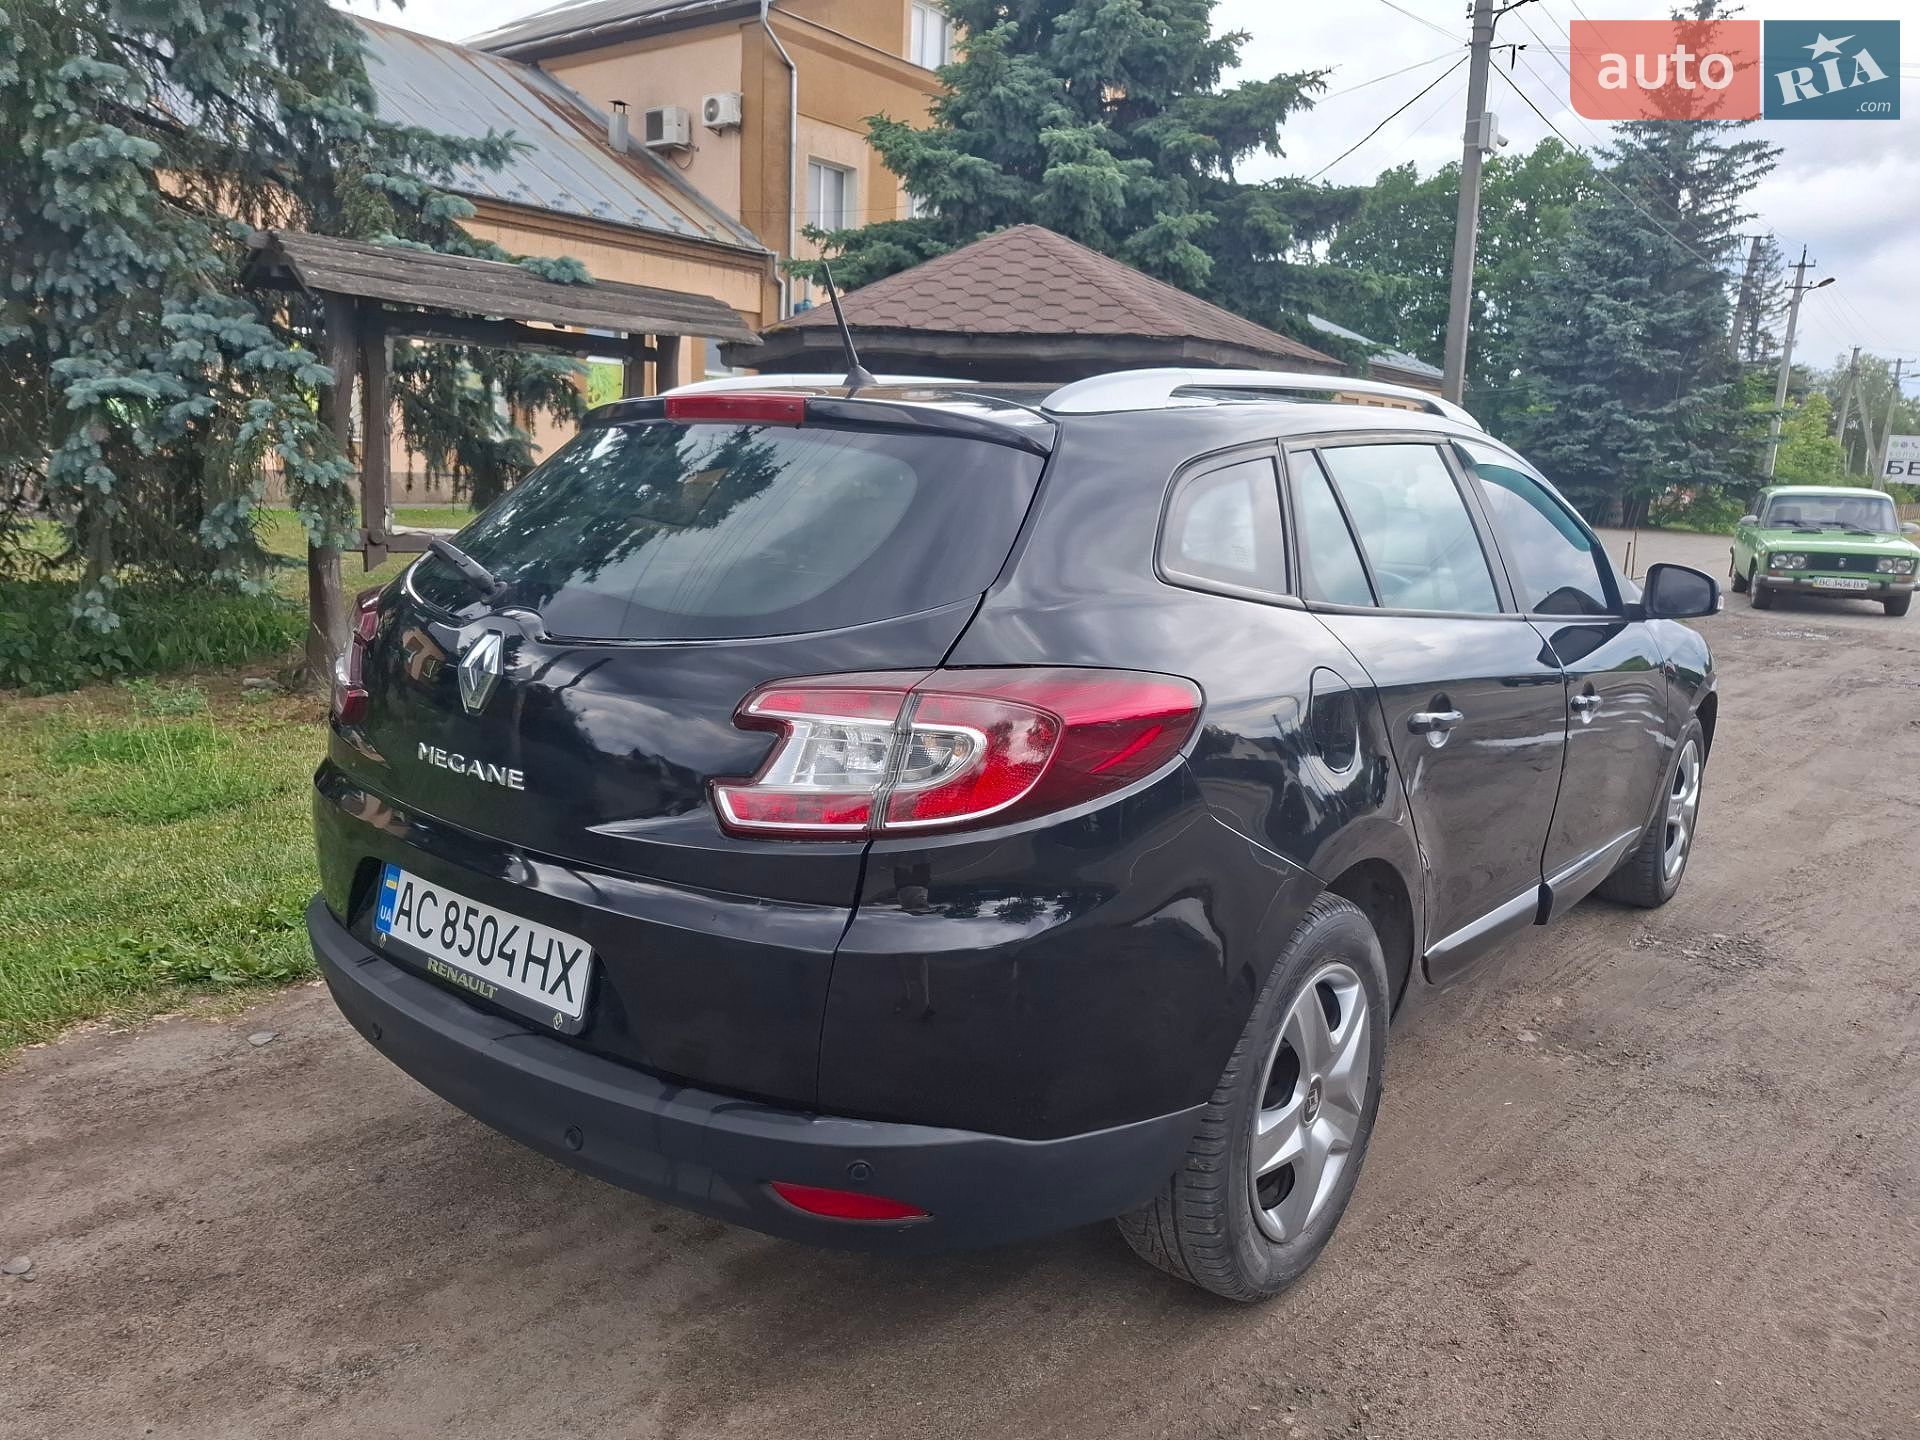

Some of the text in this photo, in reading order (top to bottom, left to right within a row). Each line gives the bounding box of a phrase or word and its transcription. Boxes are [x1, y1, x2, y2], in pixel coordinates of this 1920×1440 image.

[418, 742, 525, 791] MEGANE
[380, 905, 392, 924] UA
[393, 881, 584, 1004] AC 8504 HX
[427, 956, 498, 1000] RENAULT
